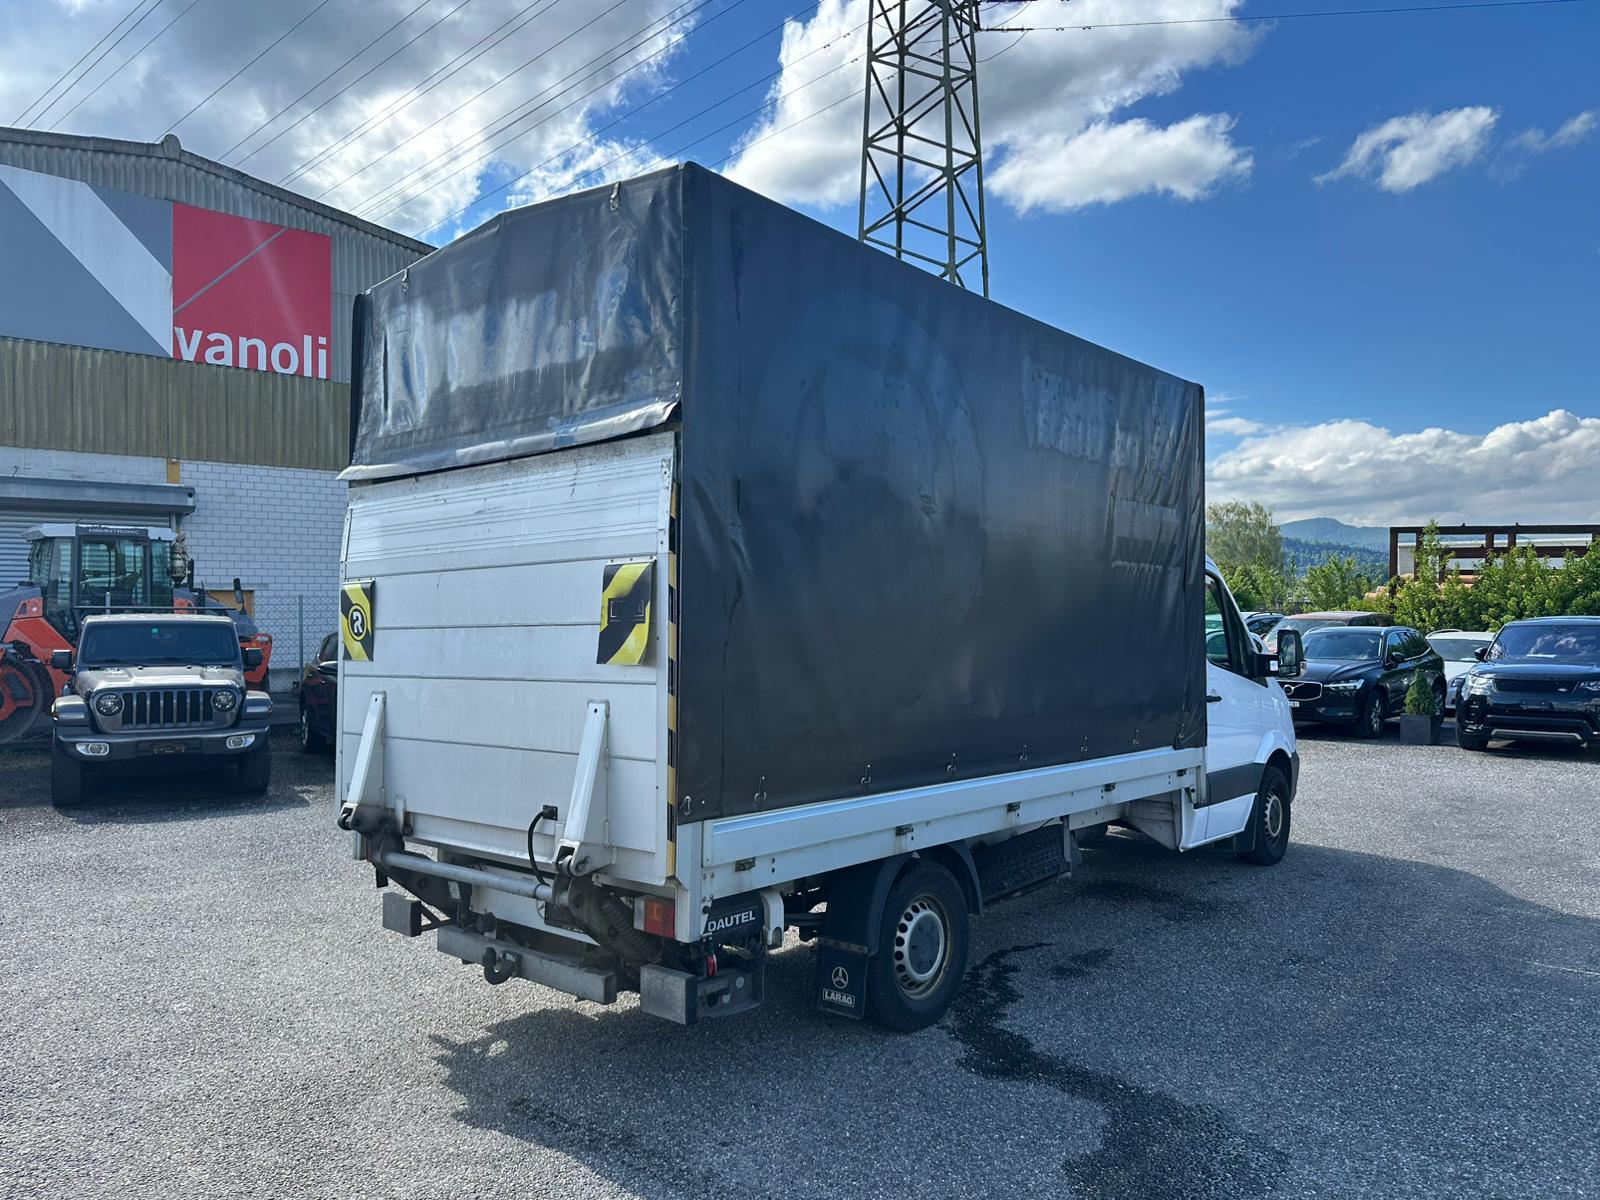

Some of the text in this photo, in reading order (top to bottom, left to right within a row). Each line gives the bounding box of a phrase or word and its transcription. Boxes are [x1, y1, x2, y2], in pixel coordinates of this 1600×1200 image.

[174, 326, 327, 379] vanoli
[707, 910, 756, 932] DAUTEL
[824, 990, 853, 1006] LARAG
